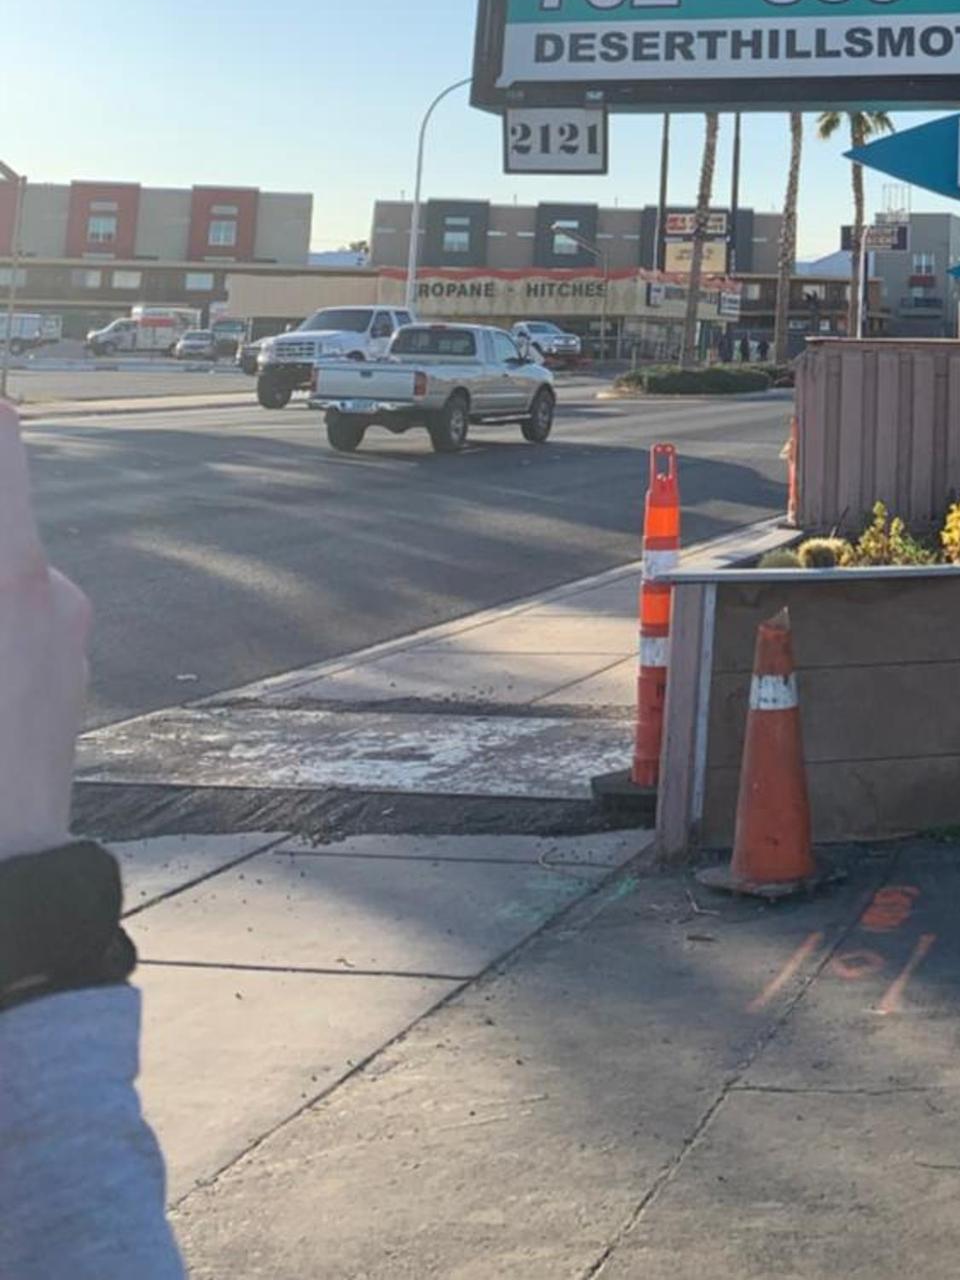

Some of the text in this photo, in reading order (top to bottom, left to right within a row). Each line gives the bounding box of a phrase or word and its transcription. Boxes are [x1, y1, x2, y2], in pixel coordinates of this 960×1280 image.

[511, 123, 598, 154] 2121
[410, 281, 608, 298] ROPANE HITCHES
